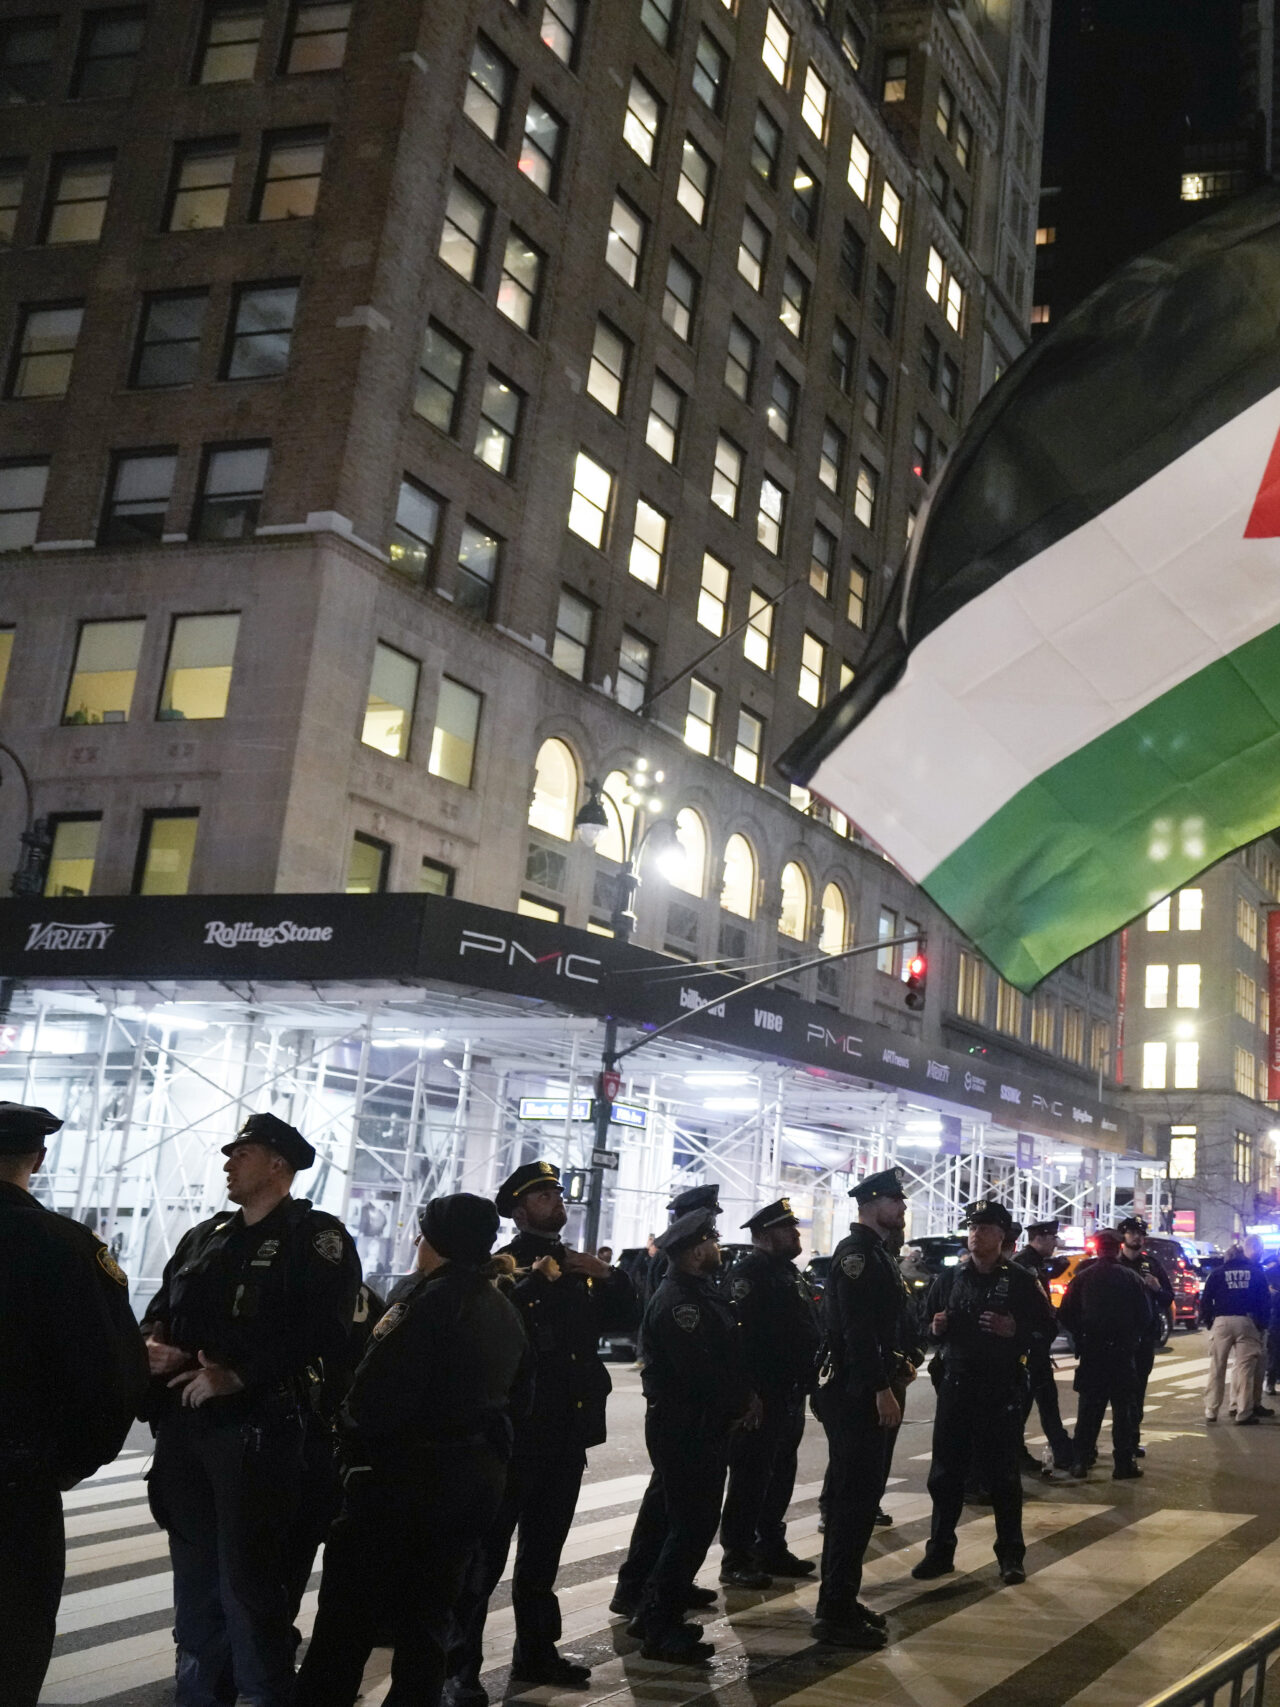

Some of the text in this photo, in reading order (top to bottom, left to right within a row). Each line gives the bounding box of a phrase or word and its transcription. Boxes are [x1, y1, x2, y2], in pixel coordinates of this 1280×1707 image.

[24, 921, 116, 951] VARIETY
[459, 930, 602, 985] PMC
[807, 1023, 863, 1057] PMC
[1224, 1270, 1251, 1282] NYPD
